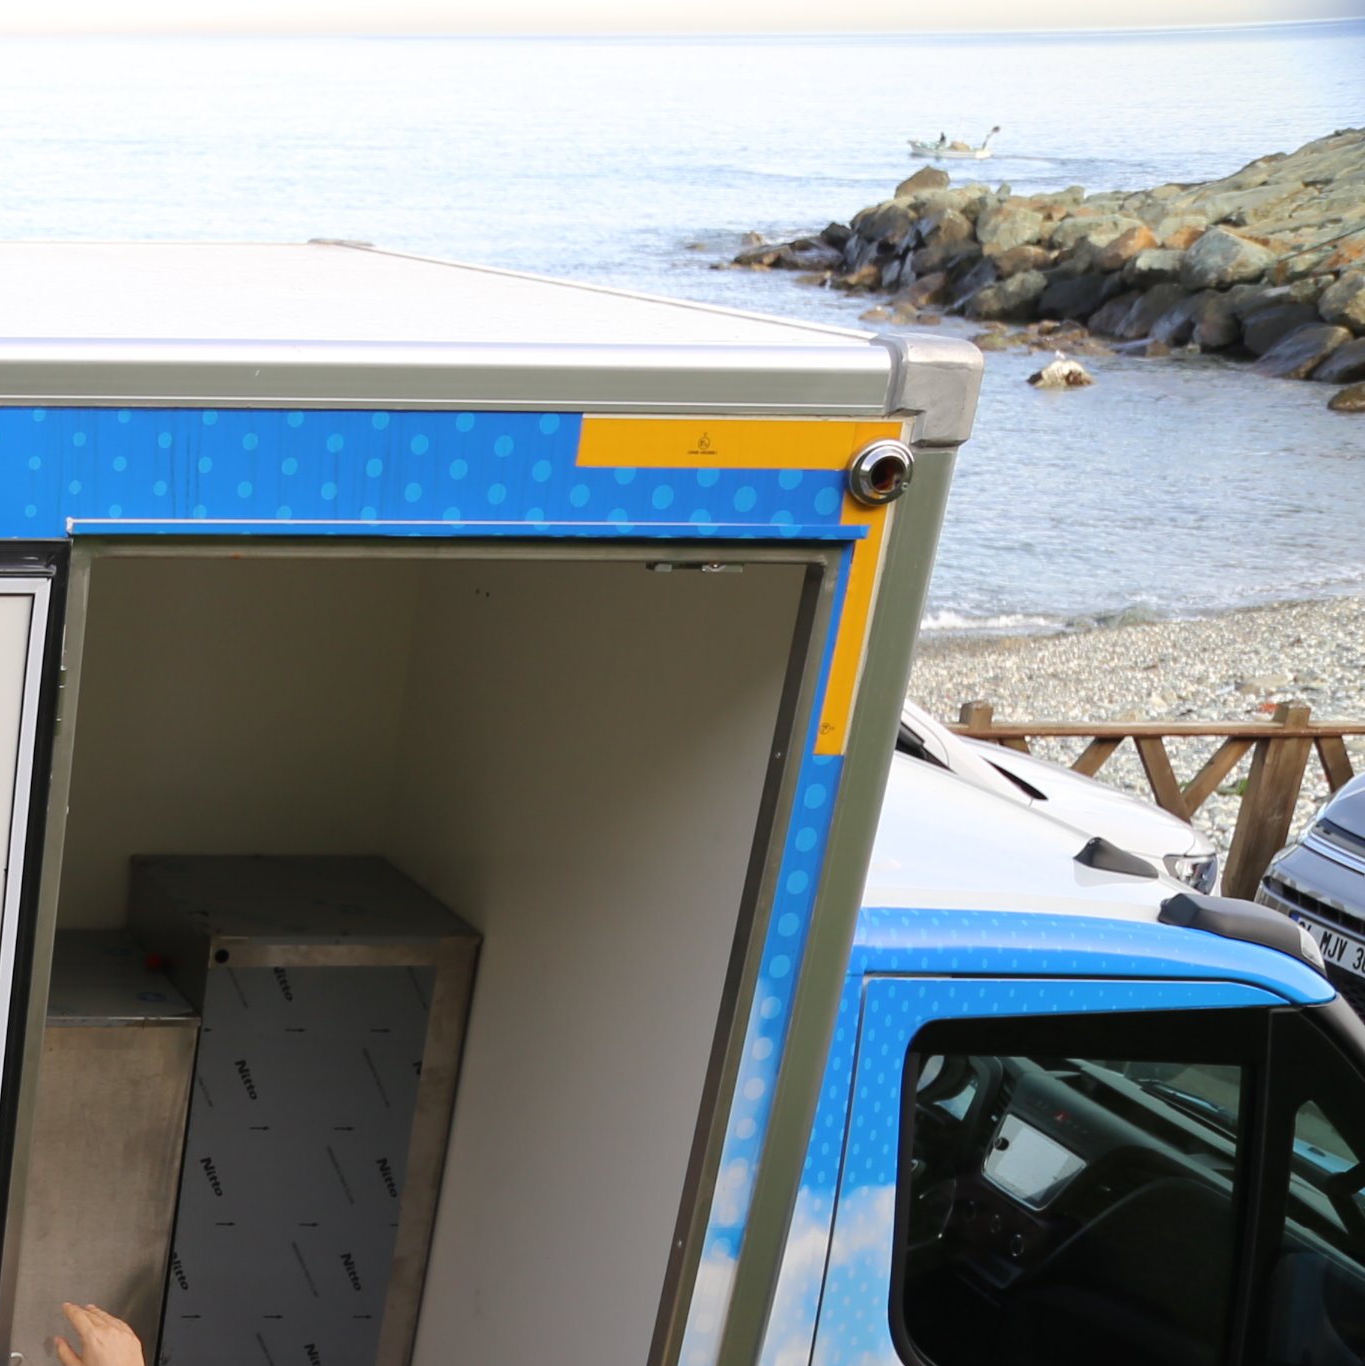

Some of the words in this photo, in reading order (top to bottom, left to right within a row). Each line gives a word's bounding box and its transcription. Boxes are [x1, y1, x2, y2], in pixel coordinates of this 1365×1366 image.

[234, 1059, 258, 1101] Nitto
[199, 1157, 223, 1198] Nitto
[375, 1157, 398, 1199] Nitto
[340, 1252, 362, 1292] Nitto
